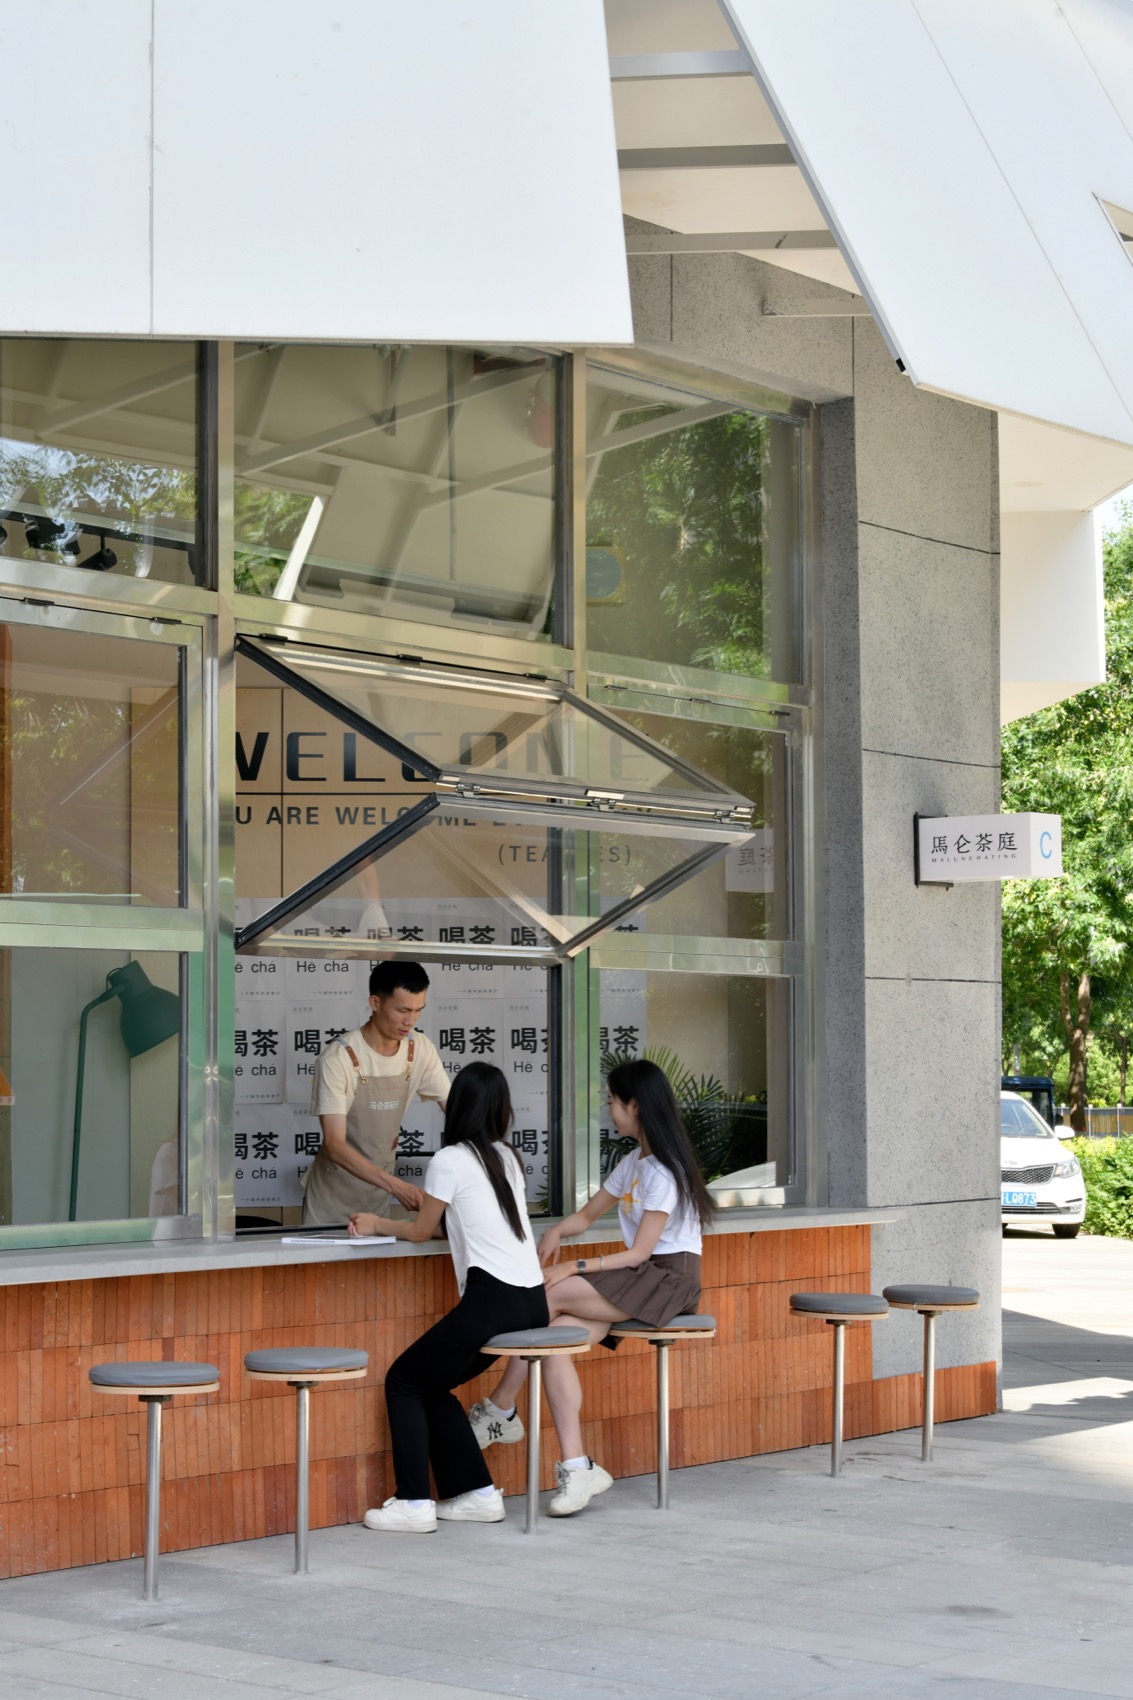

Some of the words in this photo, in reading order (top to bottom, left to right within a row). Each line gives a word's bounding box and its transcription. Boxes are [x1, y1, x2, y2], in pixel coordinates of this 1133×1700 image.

[265, 807, 320, 825] ARE
[1039, 831, 1053, 859] C
[931, 853, 1018, 863] MALUNCHATING
[251, 961, 276, 973] chá
[296, 961, 316, 973] Hē
[324, 960, 349, 973] chá
[439, 1027, 496, 1054] 喝茶
[251, 1063, 276, 1076] chá
[513, 1061, 533, 1073] Hē
[252, 1166, 277, 1179] chá
[397, 1164, 423, 1177] chá
